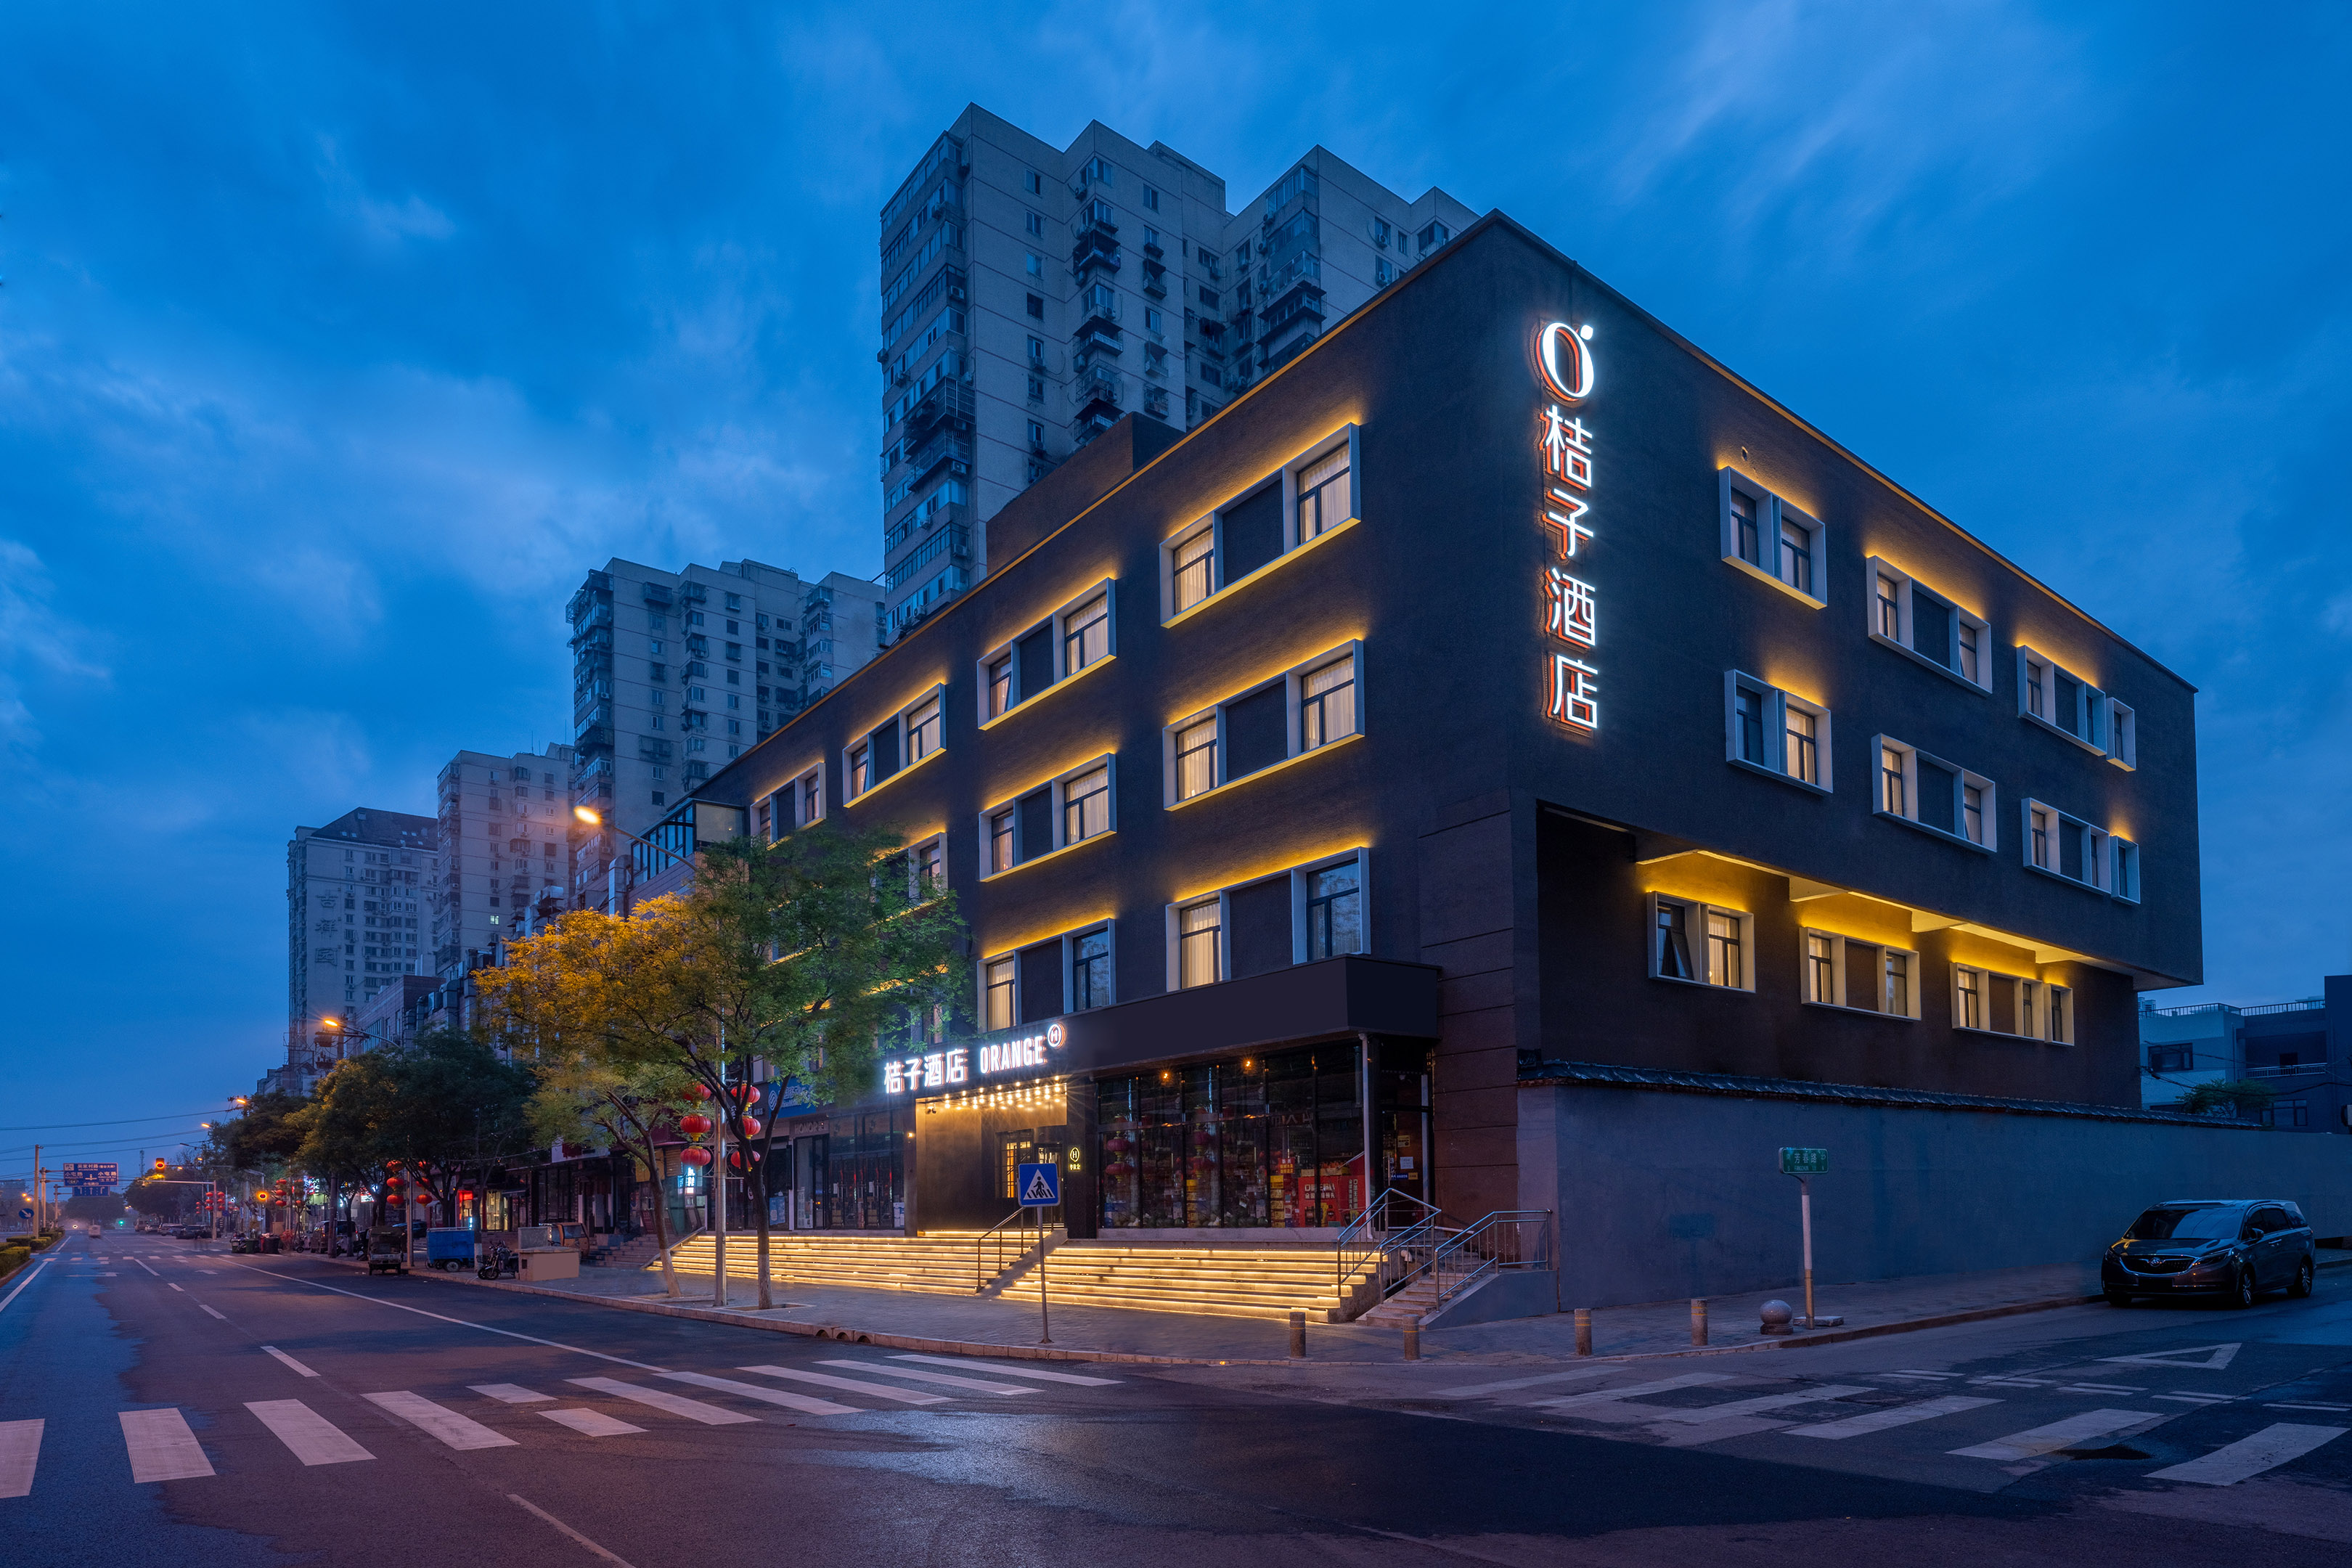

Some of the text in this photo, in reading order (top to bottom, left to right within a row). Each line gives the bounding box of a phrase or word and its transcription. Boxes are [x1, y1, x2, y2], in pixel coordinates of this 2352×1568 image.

[1543, 404, 1598, 732] 桔子酒店
[315, 889, 338, 967] 吉祥园
[884, 1048, 967, 1094] 桔子酒店
[980, 1035, 1046, 1074] ORANGE
